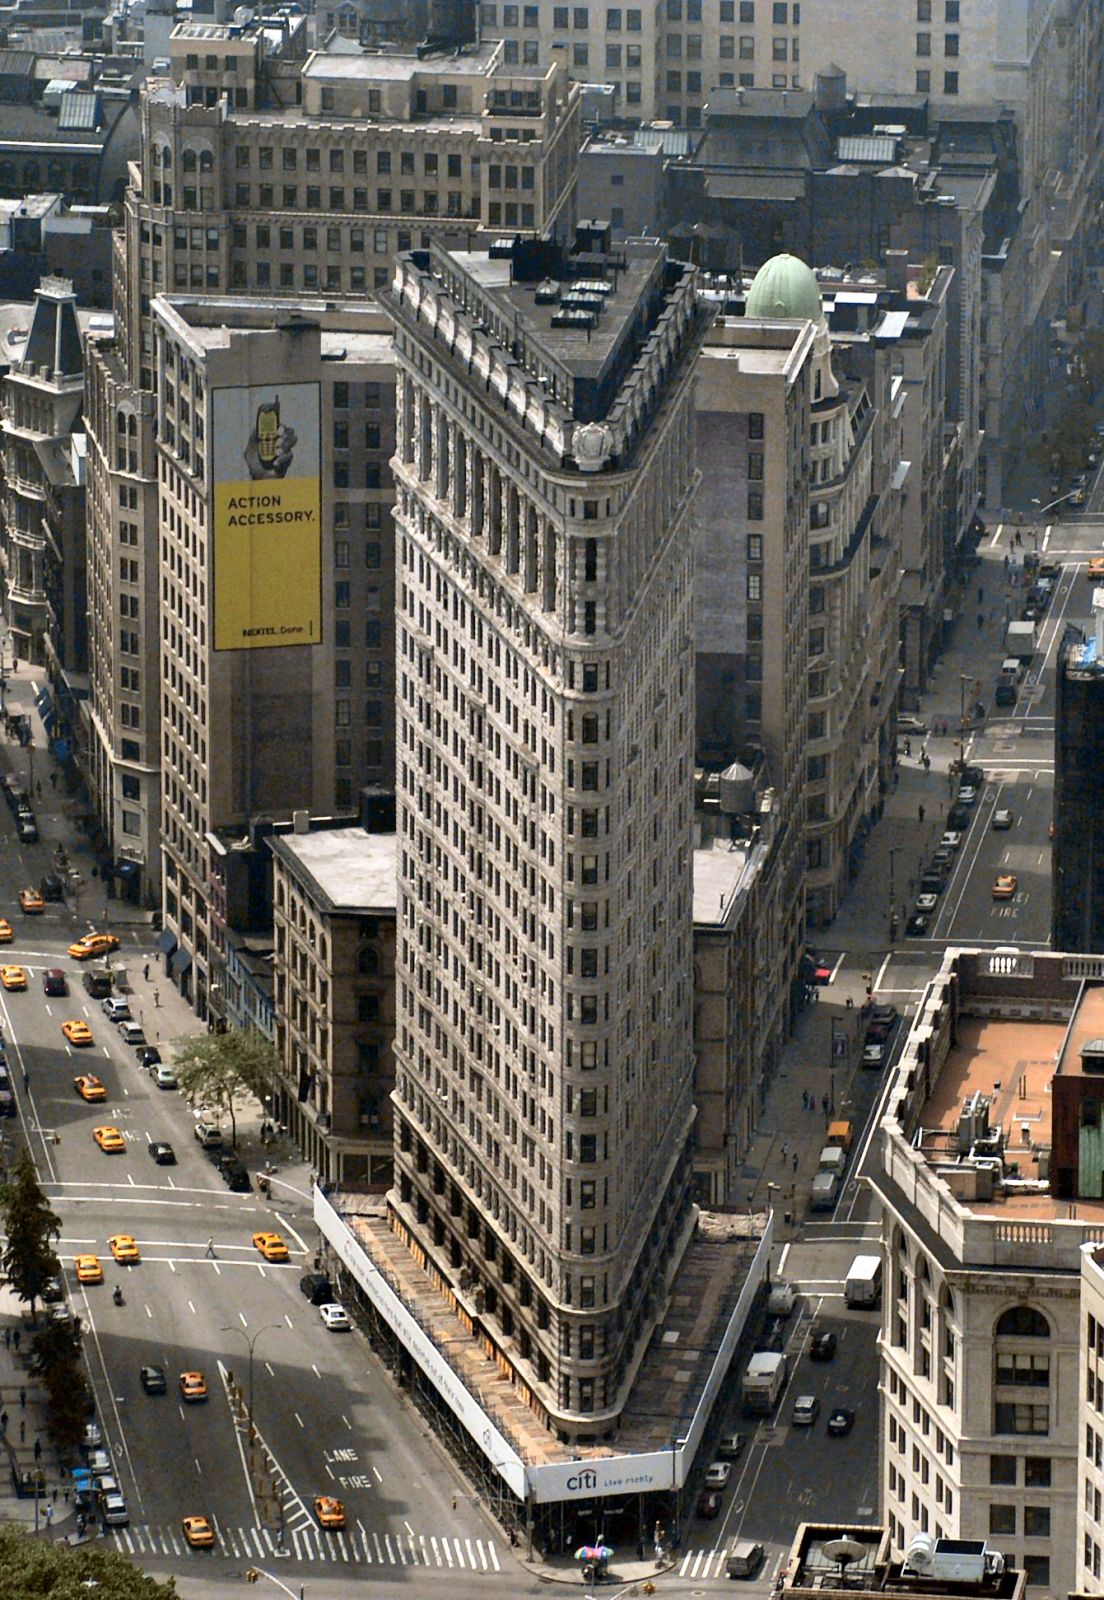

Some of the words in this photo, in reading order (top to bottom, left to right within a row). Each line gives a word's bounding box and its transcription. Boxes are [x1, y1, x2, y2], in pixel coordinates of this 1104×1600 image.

[228, 496, 281, 509] ACTION
[228, 511, 315, 526] ACCESSORY.
[323, 1449, 358, 1462] LANE
[339, 1475, 372, 1489] FIRE
[567, 1471, 597, 1490] citi
